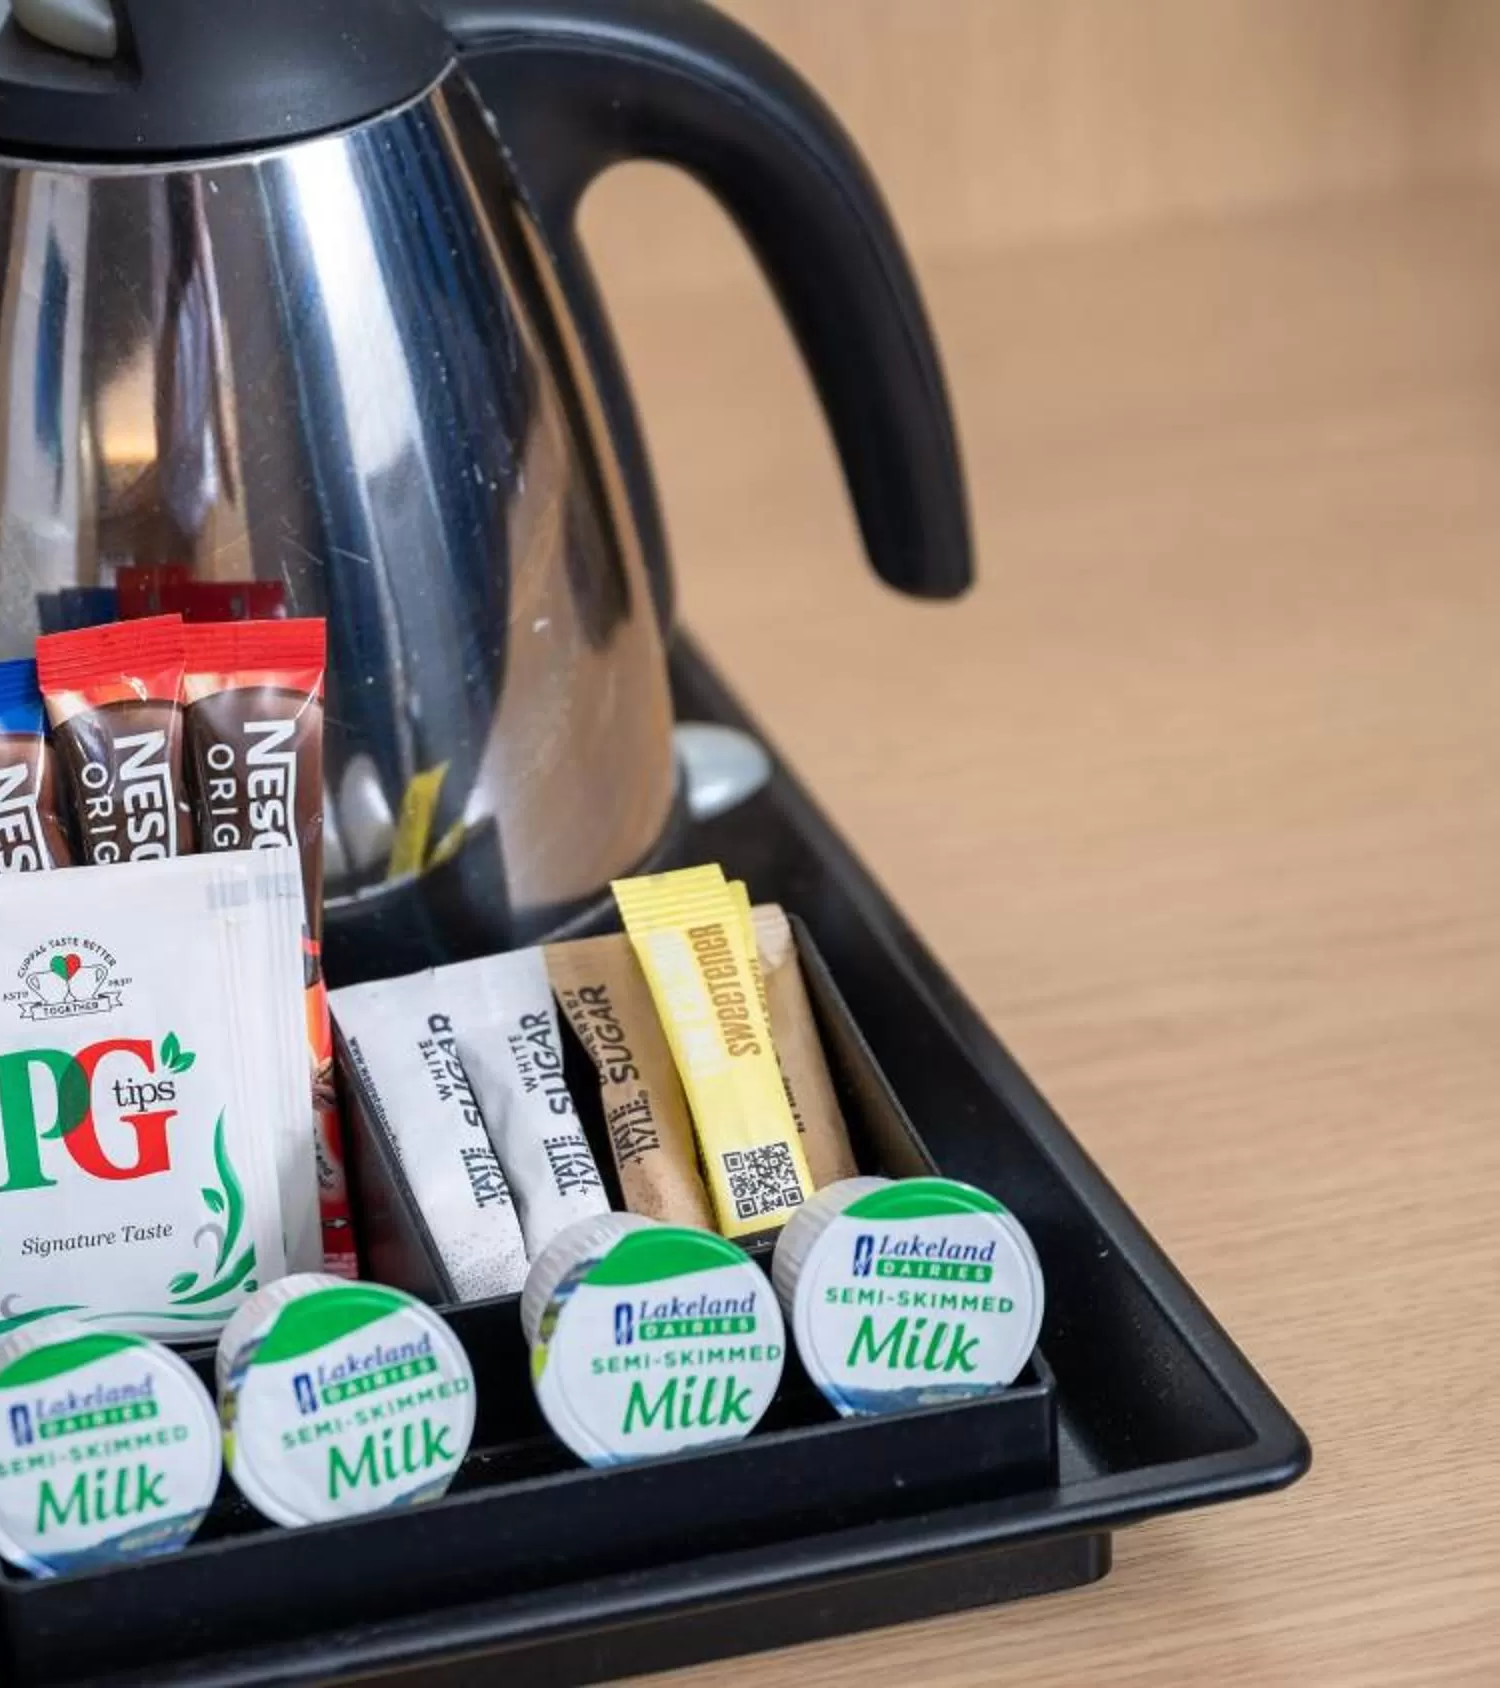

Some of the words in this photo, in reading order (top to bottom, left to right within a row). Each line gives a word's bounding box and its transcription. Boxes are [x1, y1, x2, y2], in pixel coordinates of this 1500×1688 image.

[48, 937, 79, 948] TASTE
[83, 939, 117, 967] BETTER
[578, 985, 640, 1084] SUGAR
[418, 1039, 453, 1101] WHITE
[508, 1035, 539, 1093] WHITE
[520, 1010, 572, 1115] SUGAR
[112, 1077, 176, 1112] tips
[21, 1231, 116, 1258] Signature
[121, 1222, 173, 1243] Taste
[879, 1233, 997, 1262] Lakeland
[882, 1262, 987, 1281] DAIRIES
[639, 1291, 756, 1321] Lakeland
[825, 1286, 1015, 1313] SEMI-SKIMMED
[645, 1320, 750, 1339] DAIRIES
[846, 1314, 980, 1373] Milk
[318, 1331, 432, 1386] Lakeland
[591, 1344, 782, 1375] SEMI-SKIMMED
[36, 1373, 154, 1420] Lakeland
[282, 1377, 470, 1449] SEMI-SKIMMED
[622, 1375, 752, 1435] Milk
[328, 1417, 455, 1501] Milk
[36, 1463, 169, 1536] Milk
